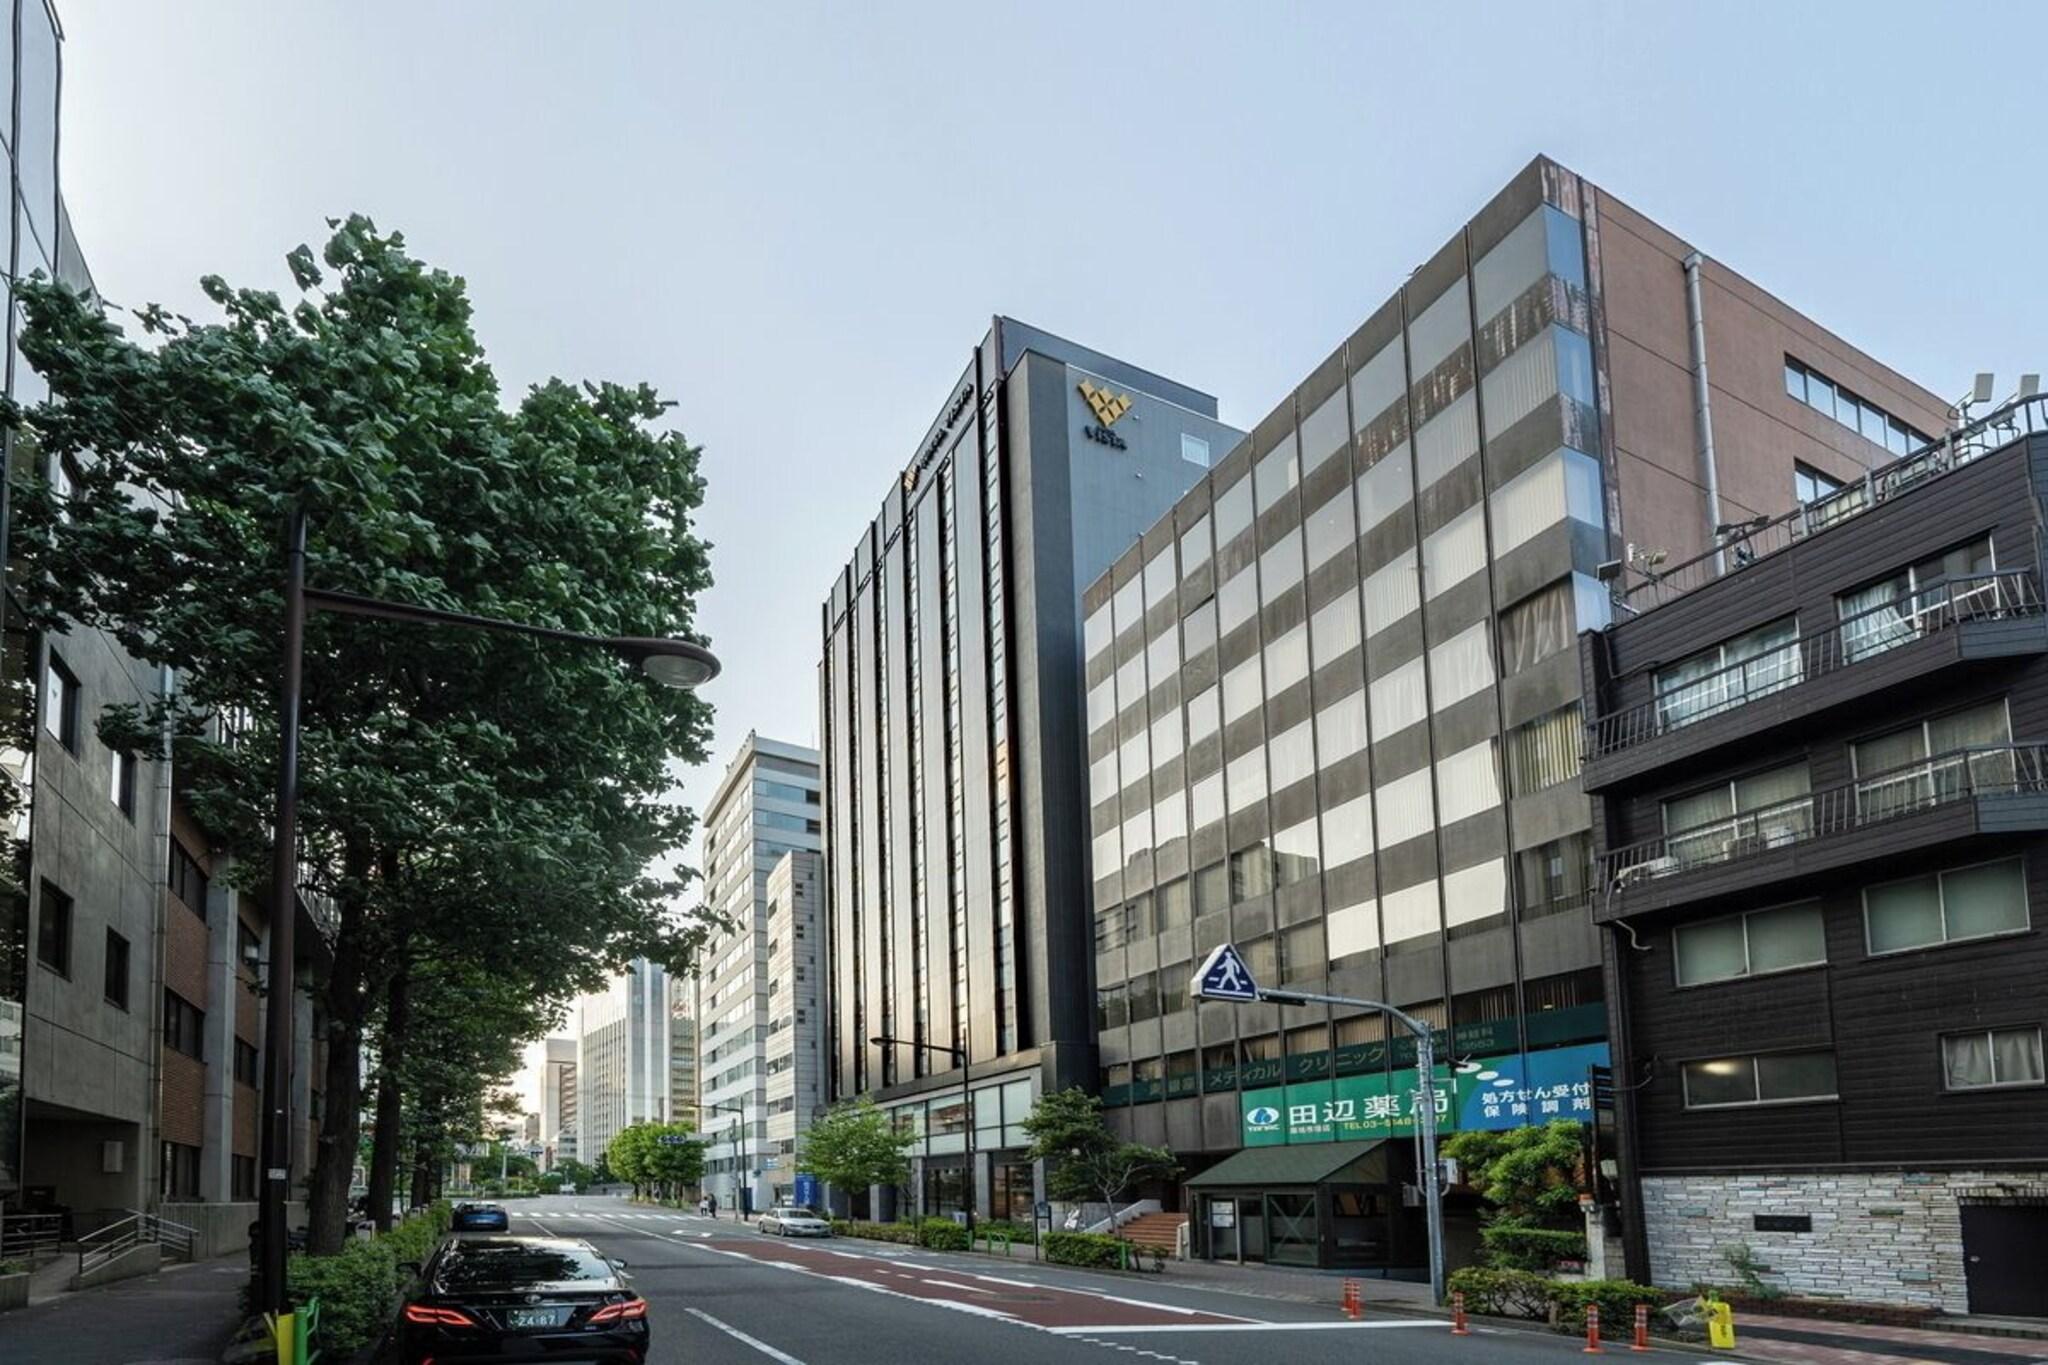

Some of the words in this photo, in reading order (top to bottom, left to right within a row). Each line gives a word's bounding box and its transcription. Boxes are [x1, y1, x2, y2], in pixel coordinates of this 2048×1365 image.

[1299, 1047, 1386, 1074] クリニック
[1482, 1082, 1590, 1105] 処方せん受付
